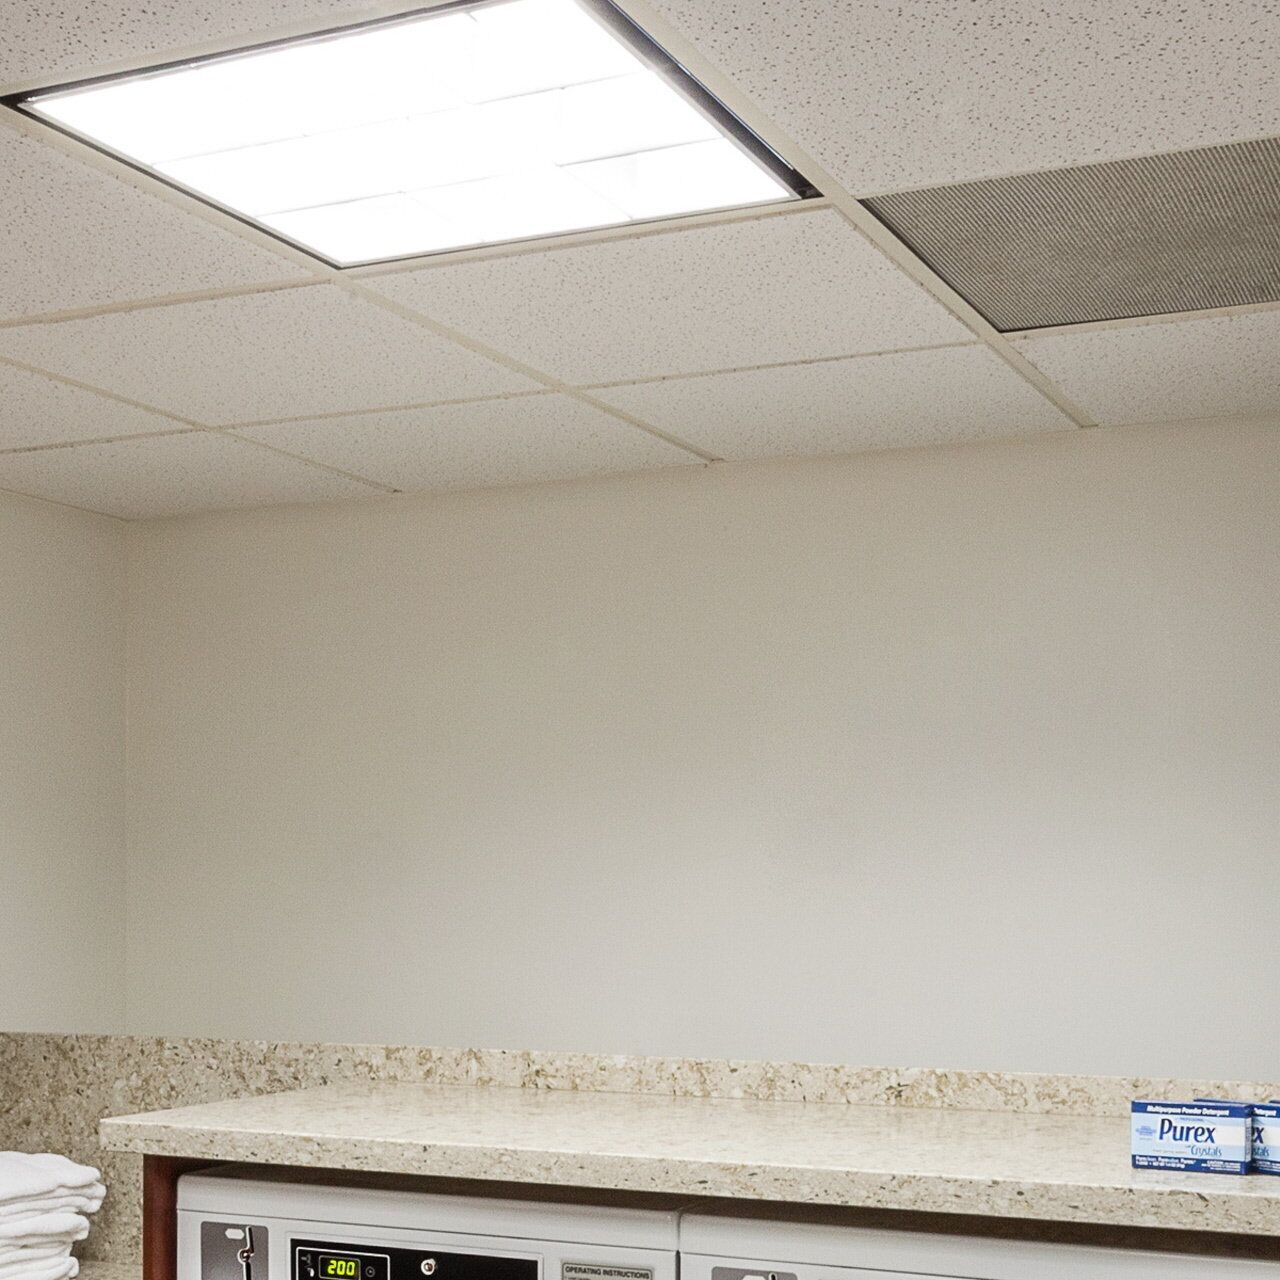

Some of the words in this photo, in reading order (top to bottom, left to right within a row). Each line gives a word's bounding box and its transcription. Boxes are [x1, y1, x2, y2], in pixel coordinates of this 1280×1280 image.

[1202, 1108, 1229, 1116] Detergent
[1159, 1118, 1216, 1143] Purex
[1191, 1145, 1222, 1157] Crystals
[327, 1260, 356, 1276] 200
[565, 1266, 601, 1275] OPERATING
[603, 1269, 649, 1279] INSTRUCTIONS
